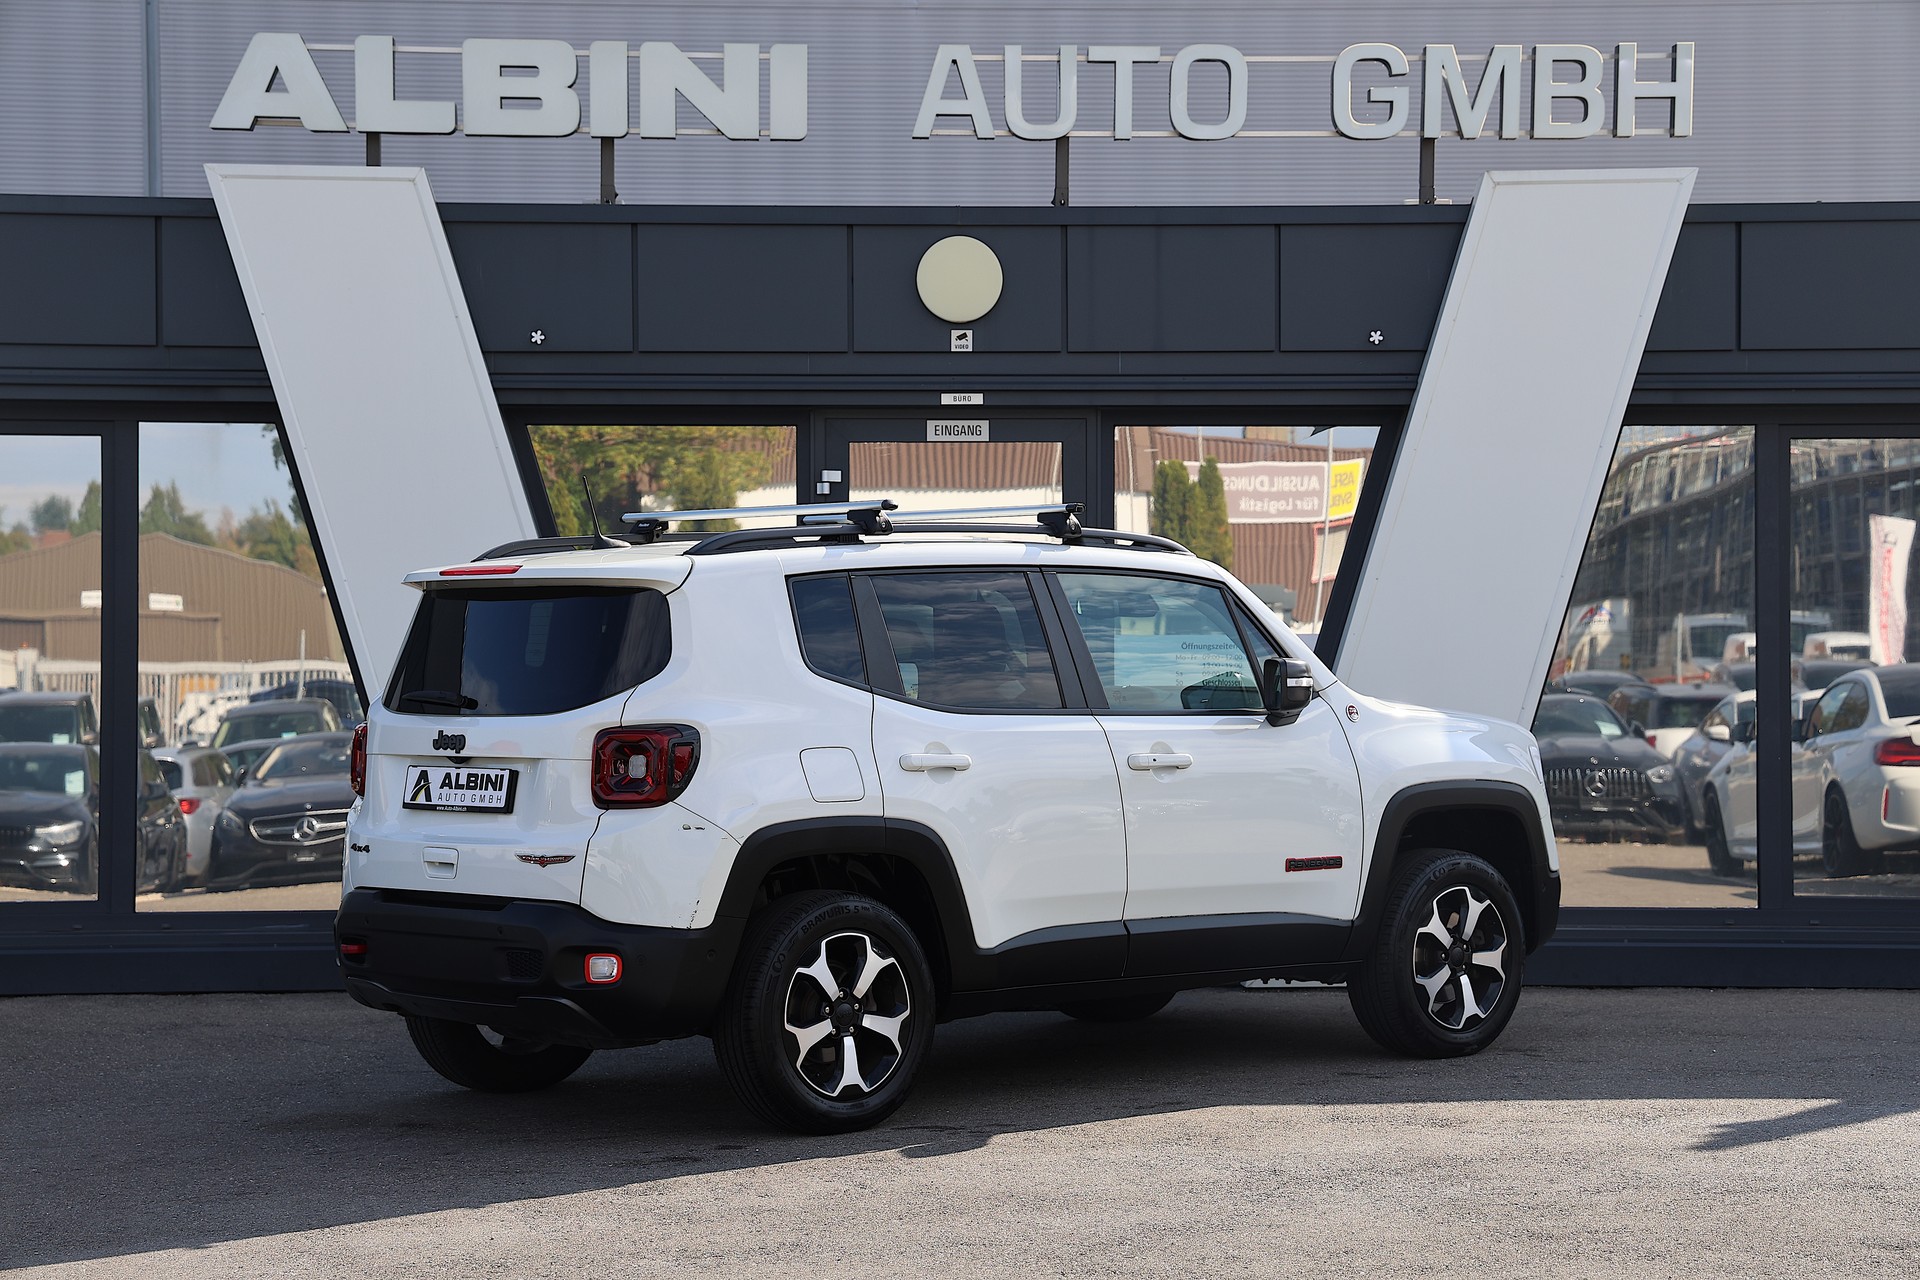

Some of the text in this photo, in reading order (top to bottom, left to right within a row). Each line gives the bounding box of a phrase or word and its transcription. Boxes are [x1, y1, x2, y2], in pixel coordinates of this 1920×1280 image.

[209, 32, 1696, 142] ALBINI AUTO GMBH
[934, 424, 982, 437] EINGANG
[1181, 642, 1238, 651] Öffnungszeiten
[432, 730, 467, 754] Jeep
[439, 772, 504, 791] ALBINI
[437, 793, 502, 804] AUTO GMBH
[351, 843, 370, 853] 4x4
[801, 905, 851, 934] BRAVURIS
